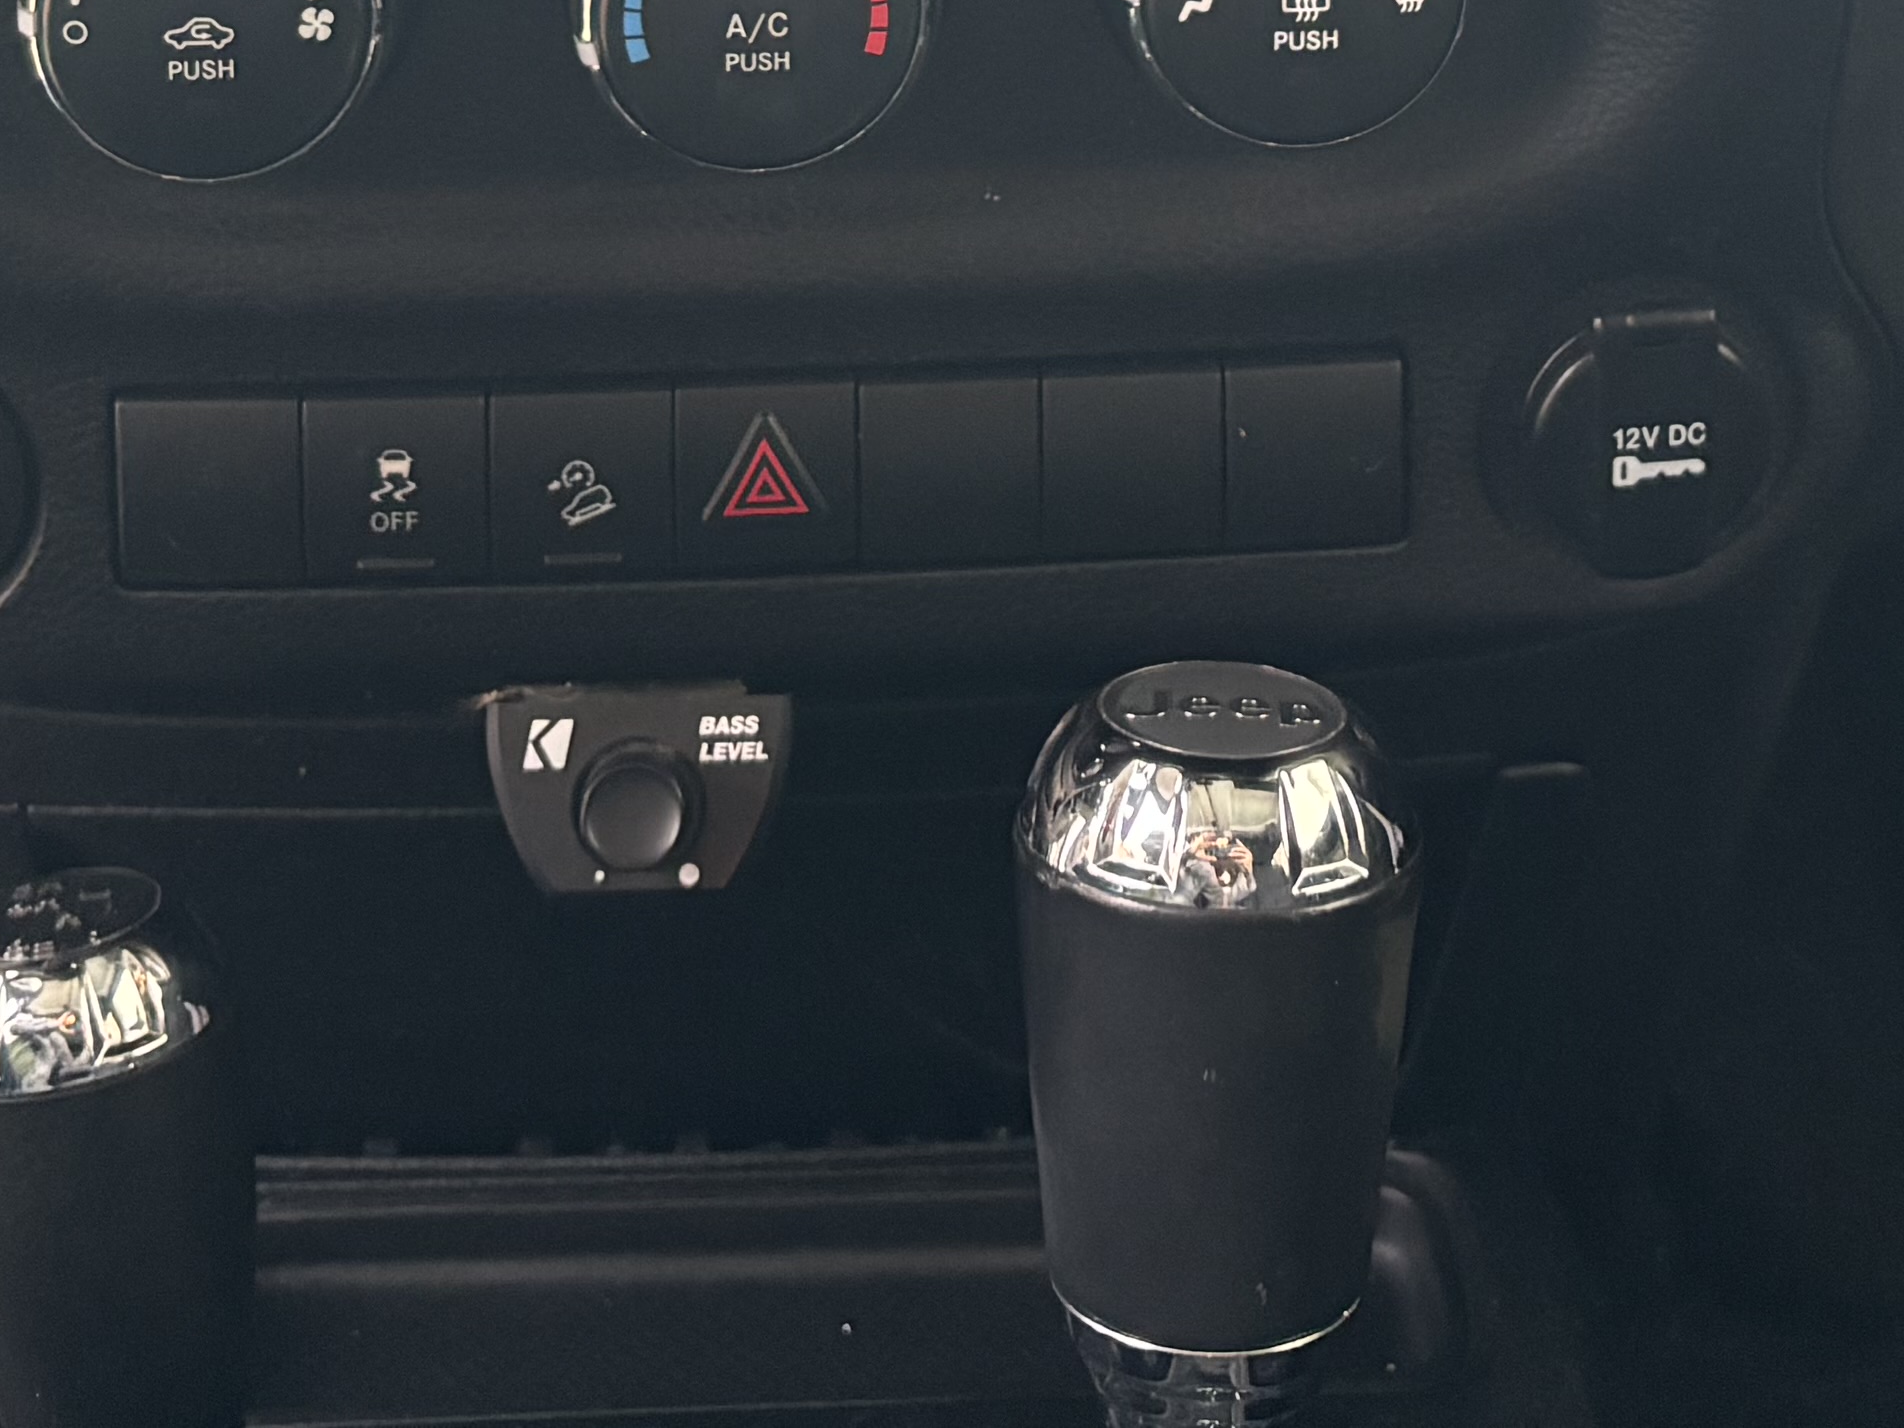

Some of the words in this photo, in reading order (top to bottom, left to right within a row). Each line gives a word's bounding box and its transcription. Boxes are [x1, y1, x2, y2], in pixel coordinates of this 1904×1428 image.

[725, 11, 789, 44] A/C
[1273, 29, 1340, 52] PUSH
[168, 58, 235, 81] PUSH
[725, 51, 791, 72] PUSH
[1612, 425, 1661, 451] 12V
[1668, 421, 1706, 447] DC
[369, 510, 420, 534] OFF
[1125, 691, 1321, 728] Jeep
[698, 714, 760, 736] BASS
[699, 740, 770, 763] LEVEL
